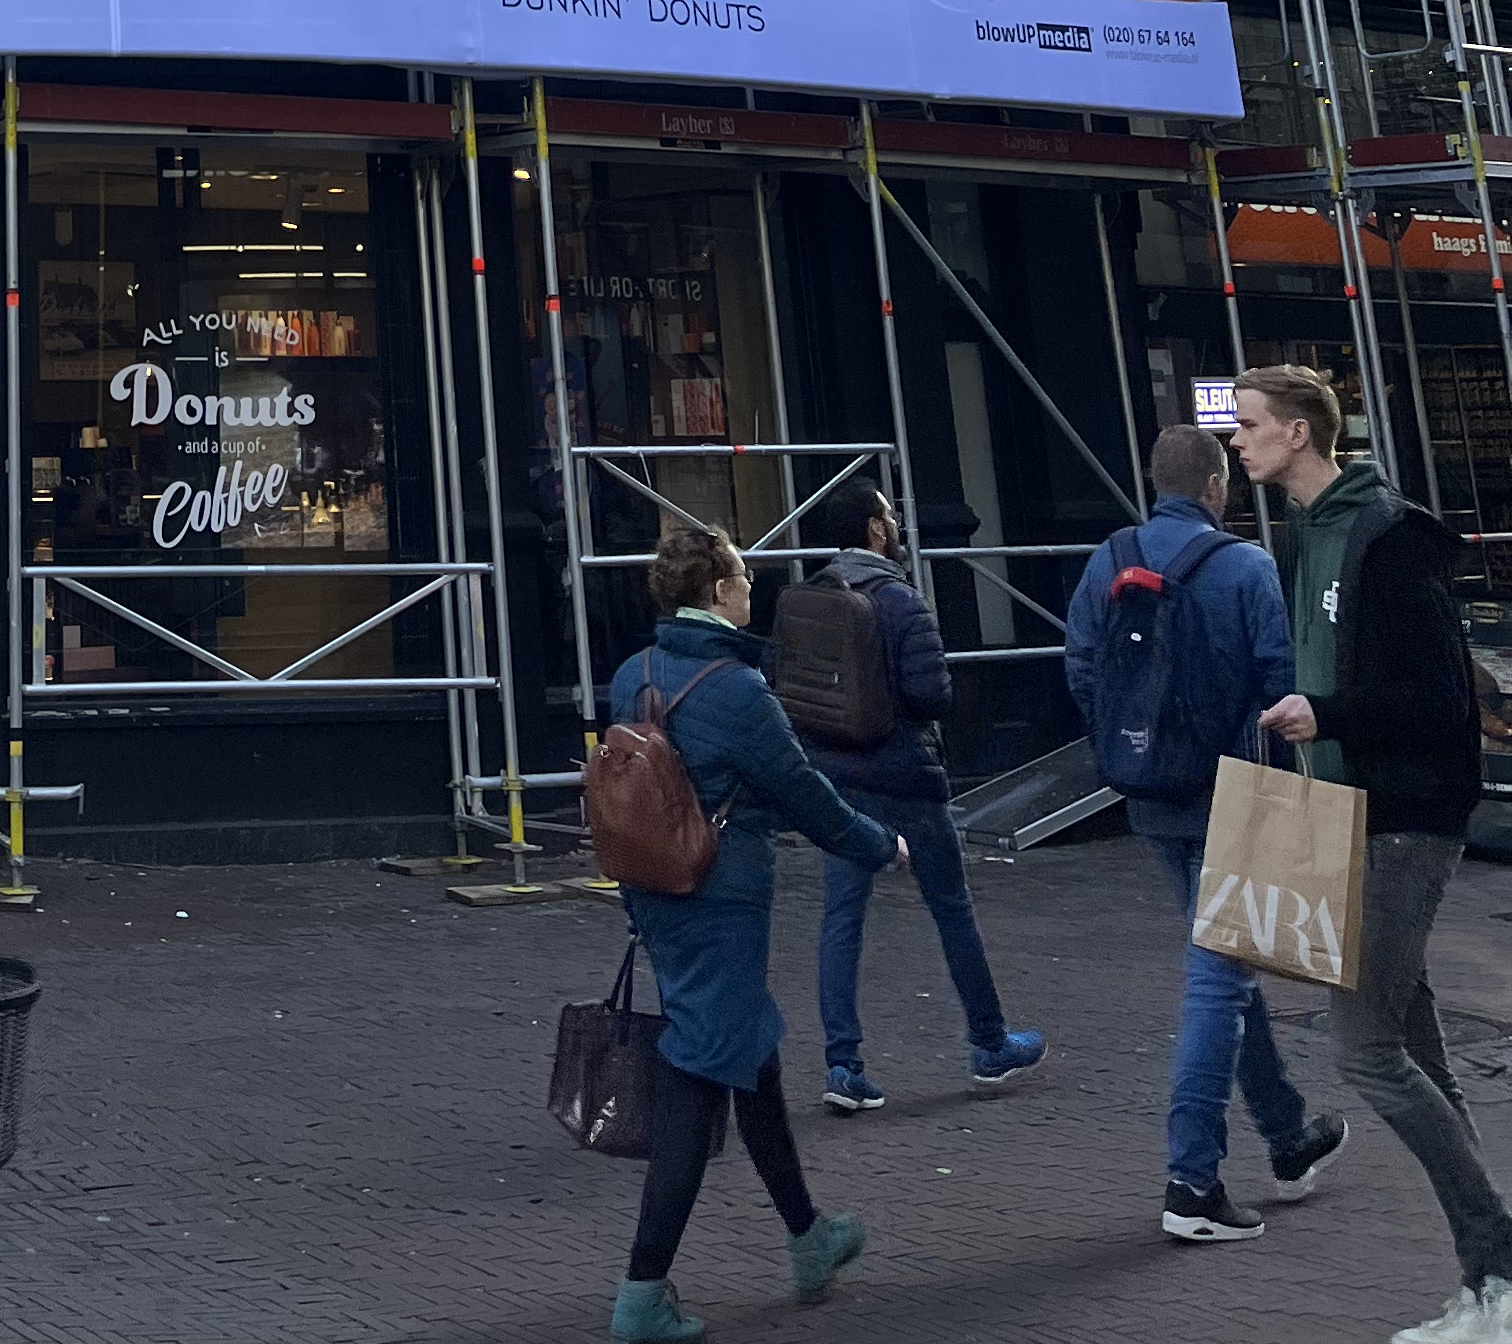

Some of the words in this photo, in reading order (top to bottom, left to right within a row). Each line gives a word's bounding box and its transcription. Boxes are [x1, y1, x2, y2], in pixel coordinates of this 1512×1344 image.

[1102, 24, 1134, 47] (020)
[1138, 28, 1151, 45] 67
[1156, 30, 1171, 46] 64
[1174, 30, 1196, 47] 164
[661, 112, 714, 136] Layher
[1432, 231, 1477, 257] haags
[1478, 234, 1511, 254] fmi
[142, 318, 184, 347] ALL
[188, 313, 236, 331] YOU
[246, 316, 300, 346] NEED
[214, 346, 230, 368] is
[109, 362, 317, 427] Donuts
[1195, 388, 1238, 412] SLEUT
[184, 437, 209, 455] and
[211, 442, 219, 455] a
[221, 441, 245, 459] cup
[247, 436, 262, 454] of
[152, 459, 289, 549] Coffee
[1192, 868, 1342, 985] ZARA
